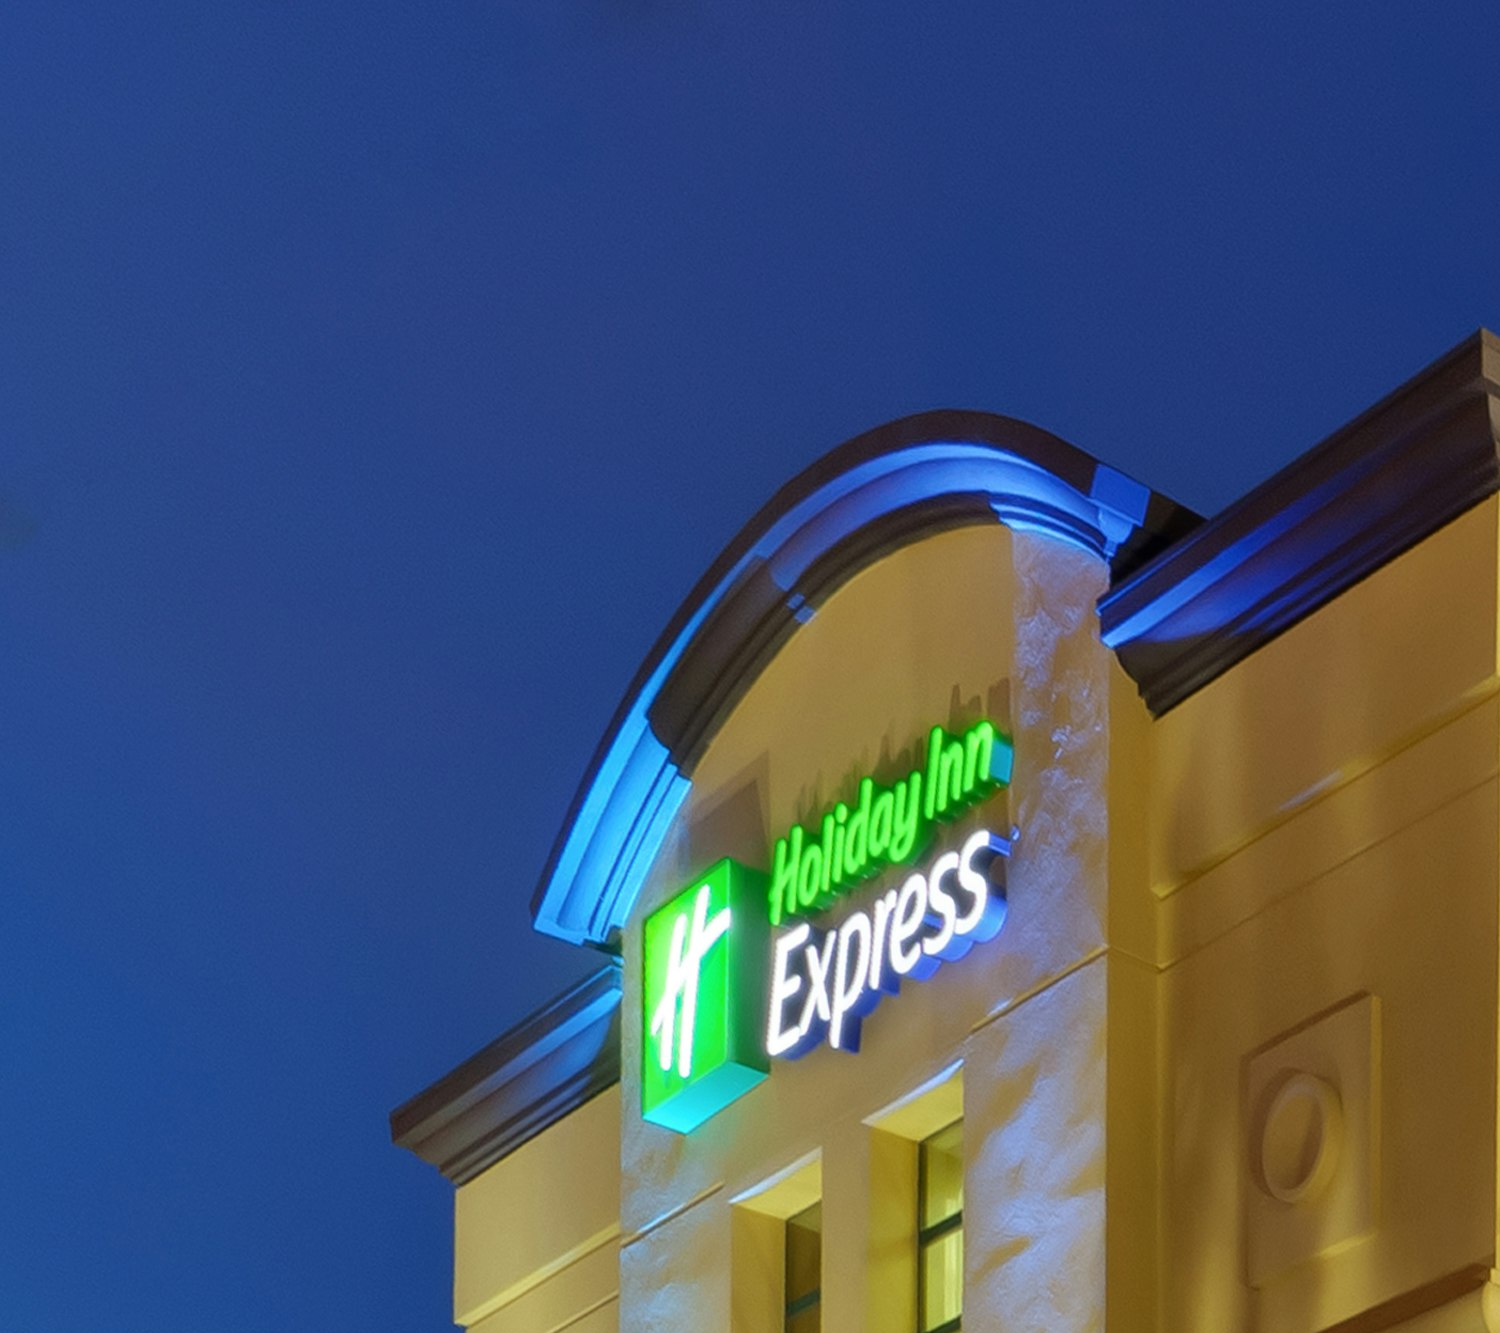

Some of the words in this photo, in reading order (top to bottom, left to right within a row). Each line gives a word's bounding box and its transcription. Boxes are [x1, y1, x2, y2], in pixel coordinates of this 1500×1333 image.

[769, 771, 921, 926] Holiday
[925, 721, 993, 819] Inn
[767, 829, 991, 1056] Express
